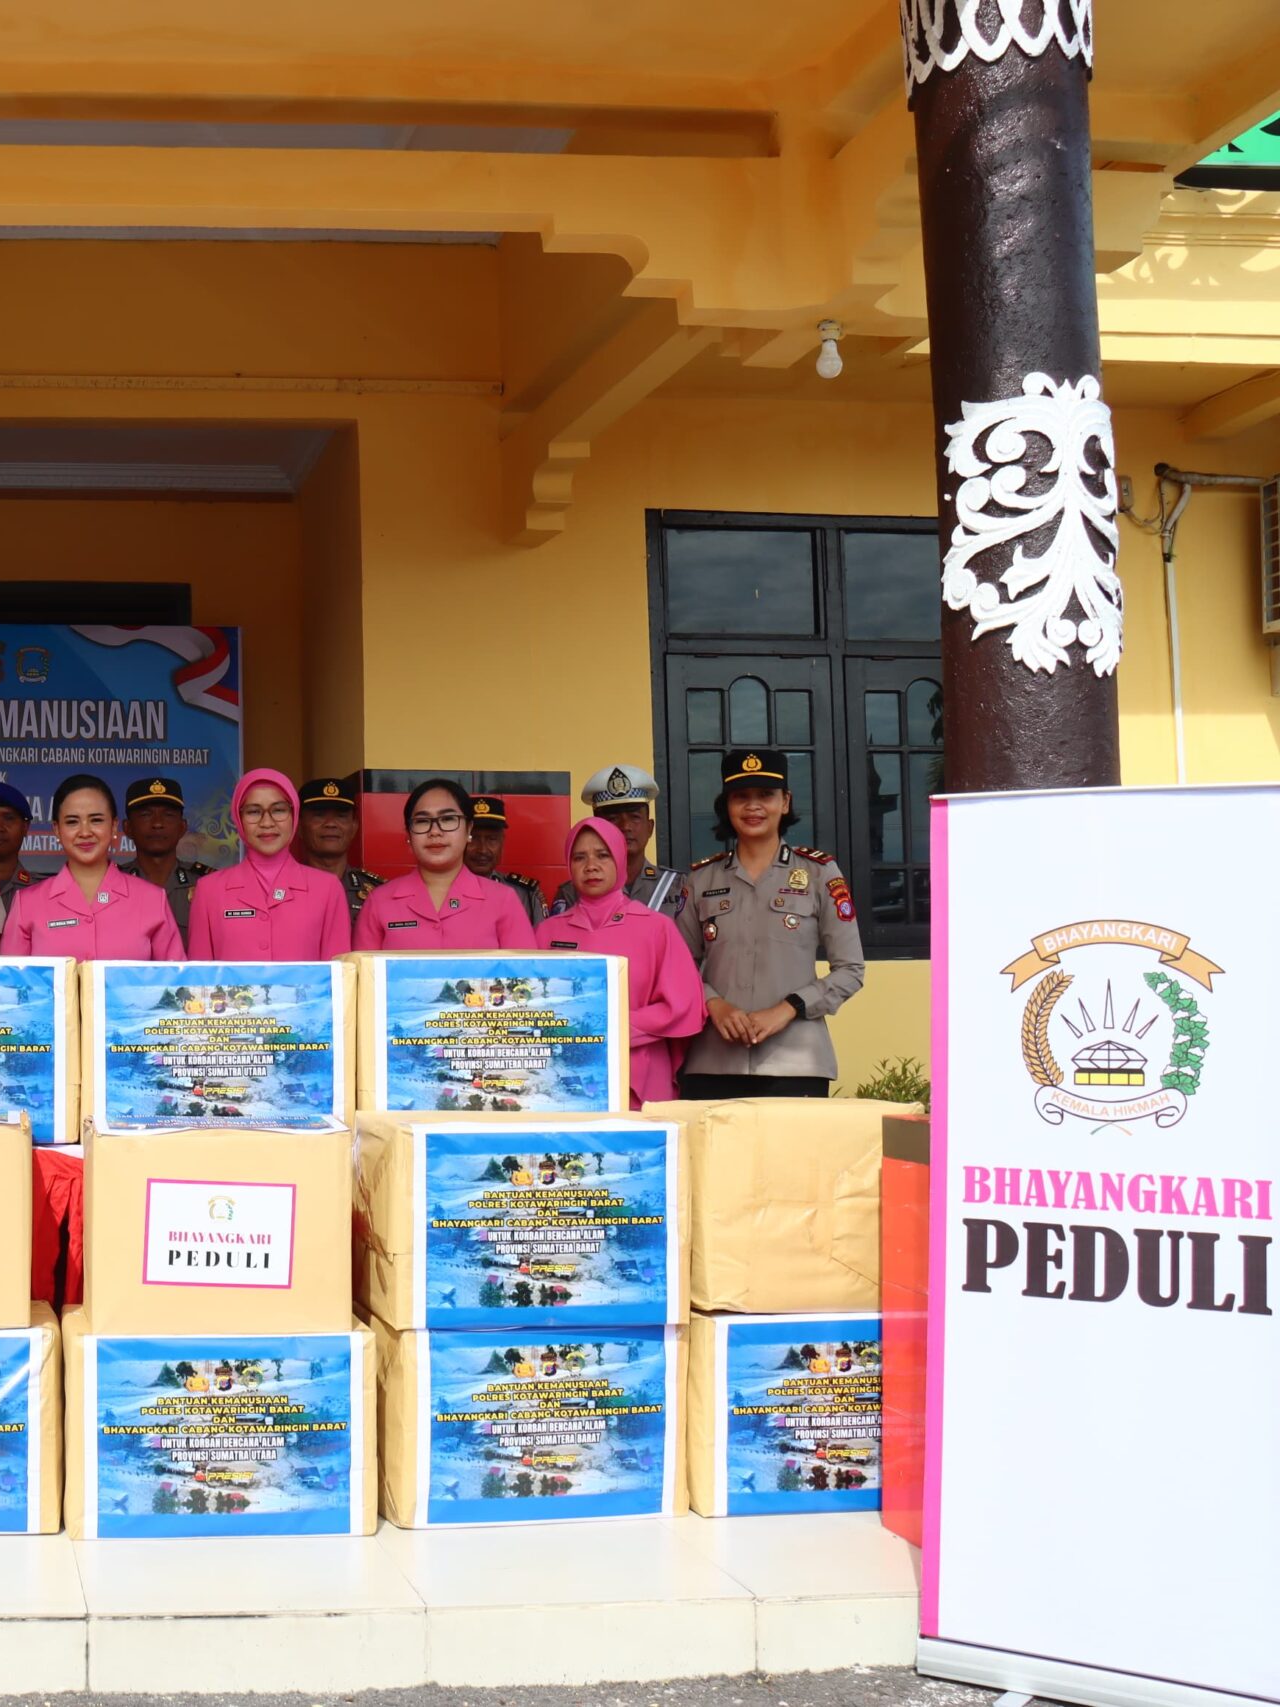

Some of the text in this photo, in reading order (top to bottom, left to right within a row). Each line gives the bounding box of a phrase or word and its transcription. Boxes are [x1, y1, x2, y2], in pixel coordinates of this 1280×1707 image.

[40, 748, 86, 763] CABANG
[88, 748, 170, 764] KOTAWARINGIN
[172, 748, 209, 765] BARAT
[1042, 921, 1178, 952] BHAYANGKARI
[486, 1011, 554, 1019] KEMANUSIAAN
[501, 1037, 572, 1045] KOTAWARINGIN
[223, 1044, 296, 1052] KOTAWARINGIN
[1050, 1090, 1171, 1117] KEMALA HIKMAH
[534, 1190, 608, 1198] KEMANUSIAAN
[962, 1165, 1273, 1220] BHAYANGKARI
[509, 1199, 586, 1208] KOTAWARINGIN
[432, 1216, 663, 1228] BHAYANGKARI CABANG KOTAWARINGIN BARAT
[168, 1230, 272, 1245] BHAYANGKARI
[495, 1242, 600, 1254] PROVINSI SUMATERA BARAT
[168, 1249, 270, 1269] PEDULI
[961, 1217, 1273, 1316] PEDULI
[487, 1381, 608, 1391] BANTUAN KEMANUSIAAN
[472, 1389, 624, 1401] POLRES KOTAWARINGIN BARAT
[767, 1388, 806, 1396] POLRES
[157, 1396, 288, 1405] BANTUAN KEMANUSIAAN
[141, 1407, 181, 1415] POLRES
[183, 1406, 265, 1414] KOTAWARINGIN
[436, 1405, 662, 1422] BHAYANGKARI CABANG KOTAWARINGIN BARAT
[733, 1406, 802, 1414] BHAYANGKARI
[805, 1405, 845, 1413] CABANG
[103, 1423, 347, 1434] BHAYANGKARI CABANG KOTAWARINGIN BARAT
[161, 1437, 285, 1448] UNTUK KORBAN BENCANA ALAM
[499, 1432, 601, 1447] PROVINSI SUMATERA BARAT
[172, 1450, 277, 1461] PROVINSI SUMATRA UTARA
